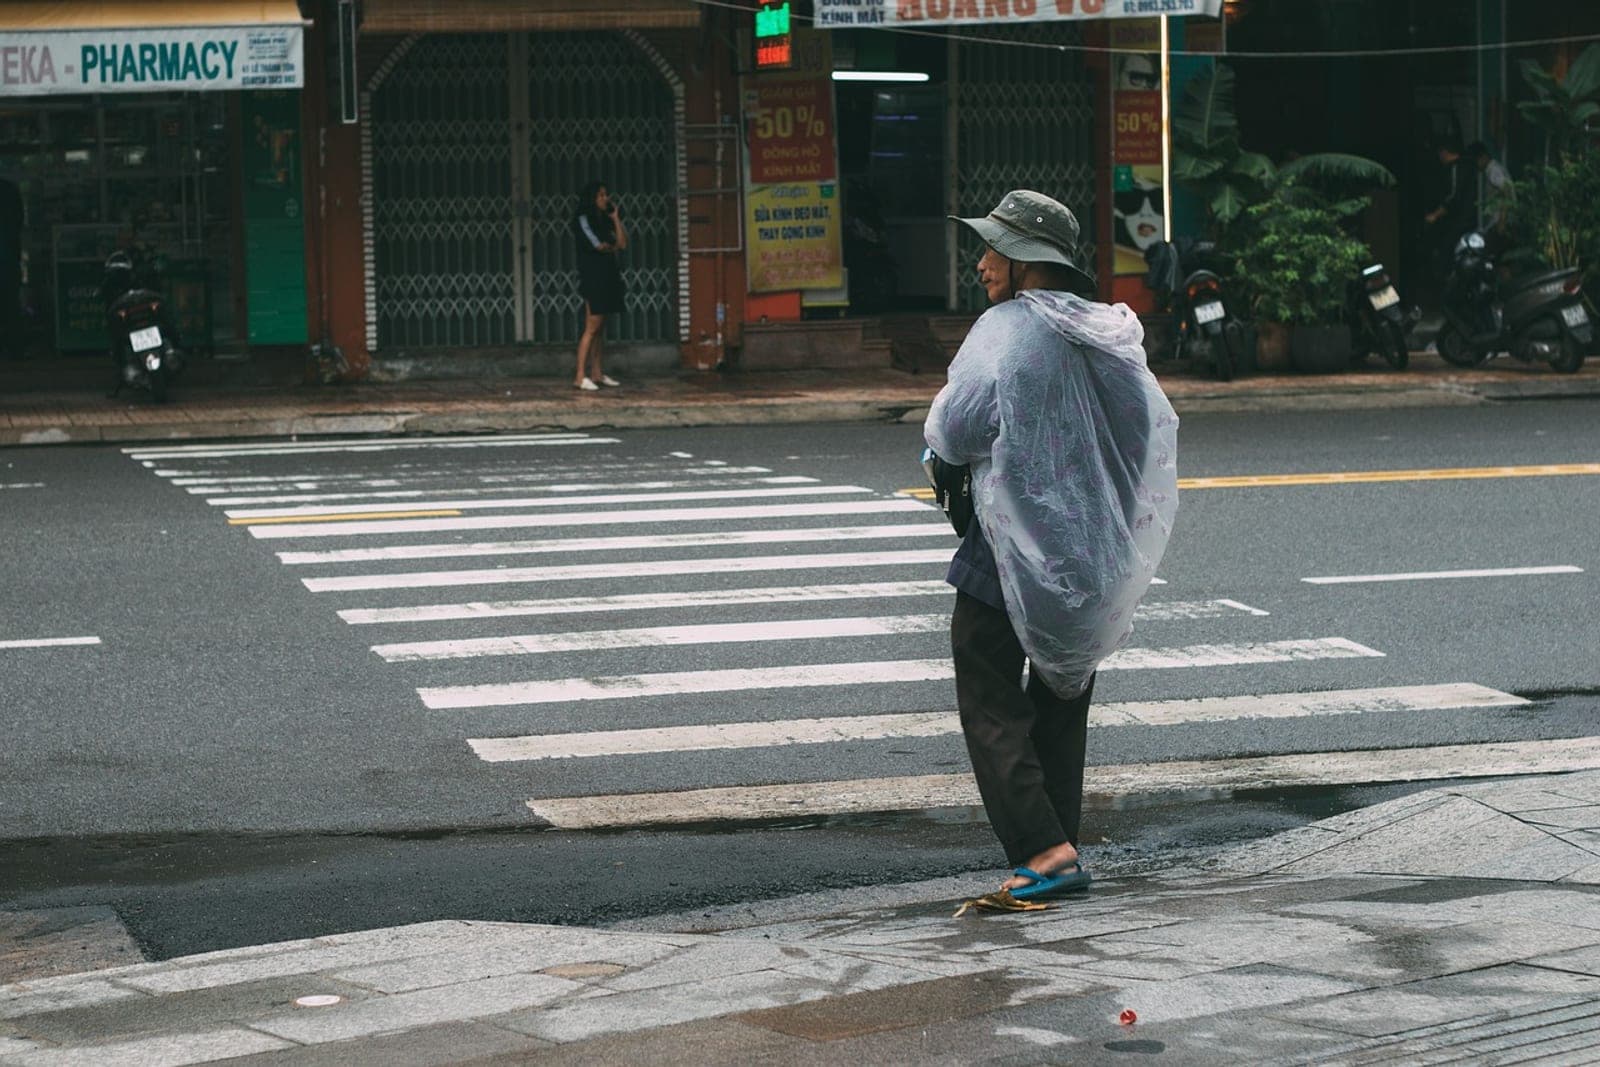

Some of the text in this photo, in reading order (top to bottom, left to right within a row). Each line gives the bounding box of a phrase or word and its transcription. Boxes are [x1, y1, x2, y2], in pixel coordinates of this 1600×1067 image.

[2, 45, 57, 85] EKA
[81, 40, 238, 84] PHARMACY
[756, 104, 826, 139] 50%
[1117, 112, 1159, 133] 50%
